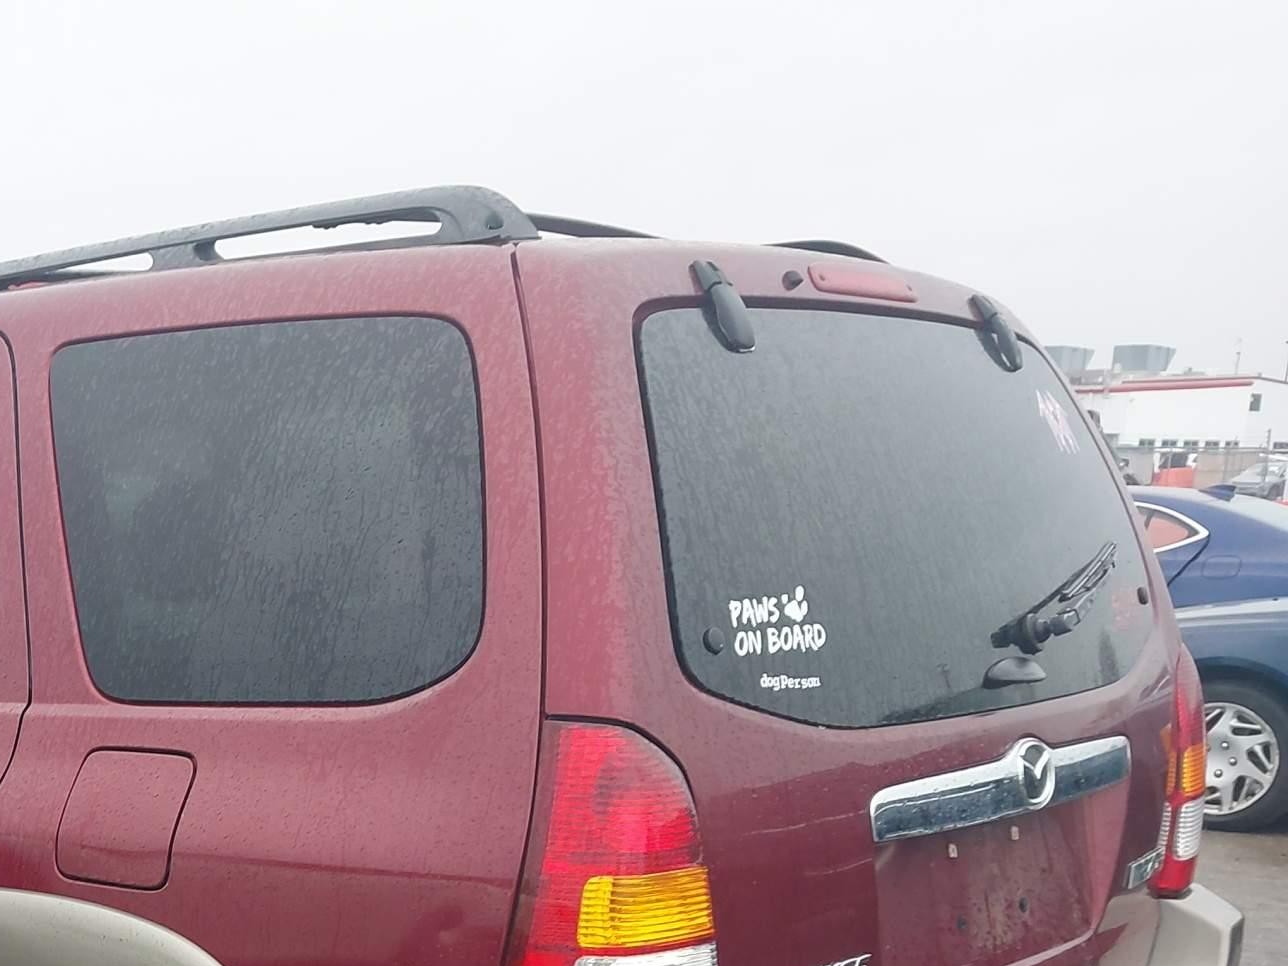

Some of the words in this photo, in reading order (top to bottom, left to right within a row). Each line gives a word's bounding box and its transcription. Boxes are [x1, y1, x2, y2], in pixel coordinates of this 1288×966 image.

[728, 596, 780, 628] PAWS
[734, 630, 762, 656] ON
[767, 623, 826, 654] BOARD
